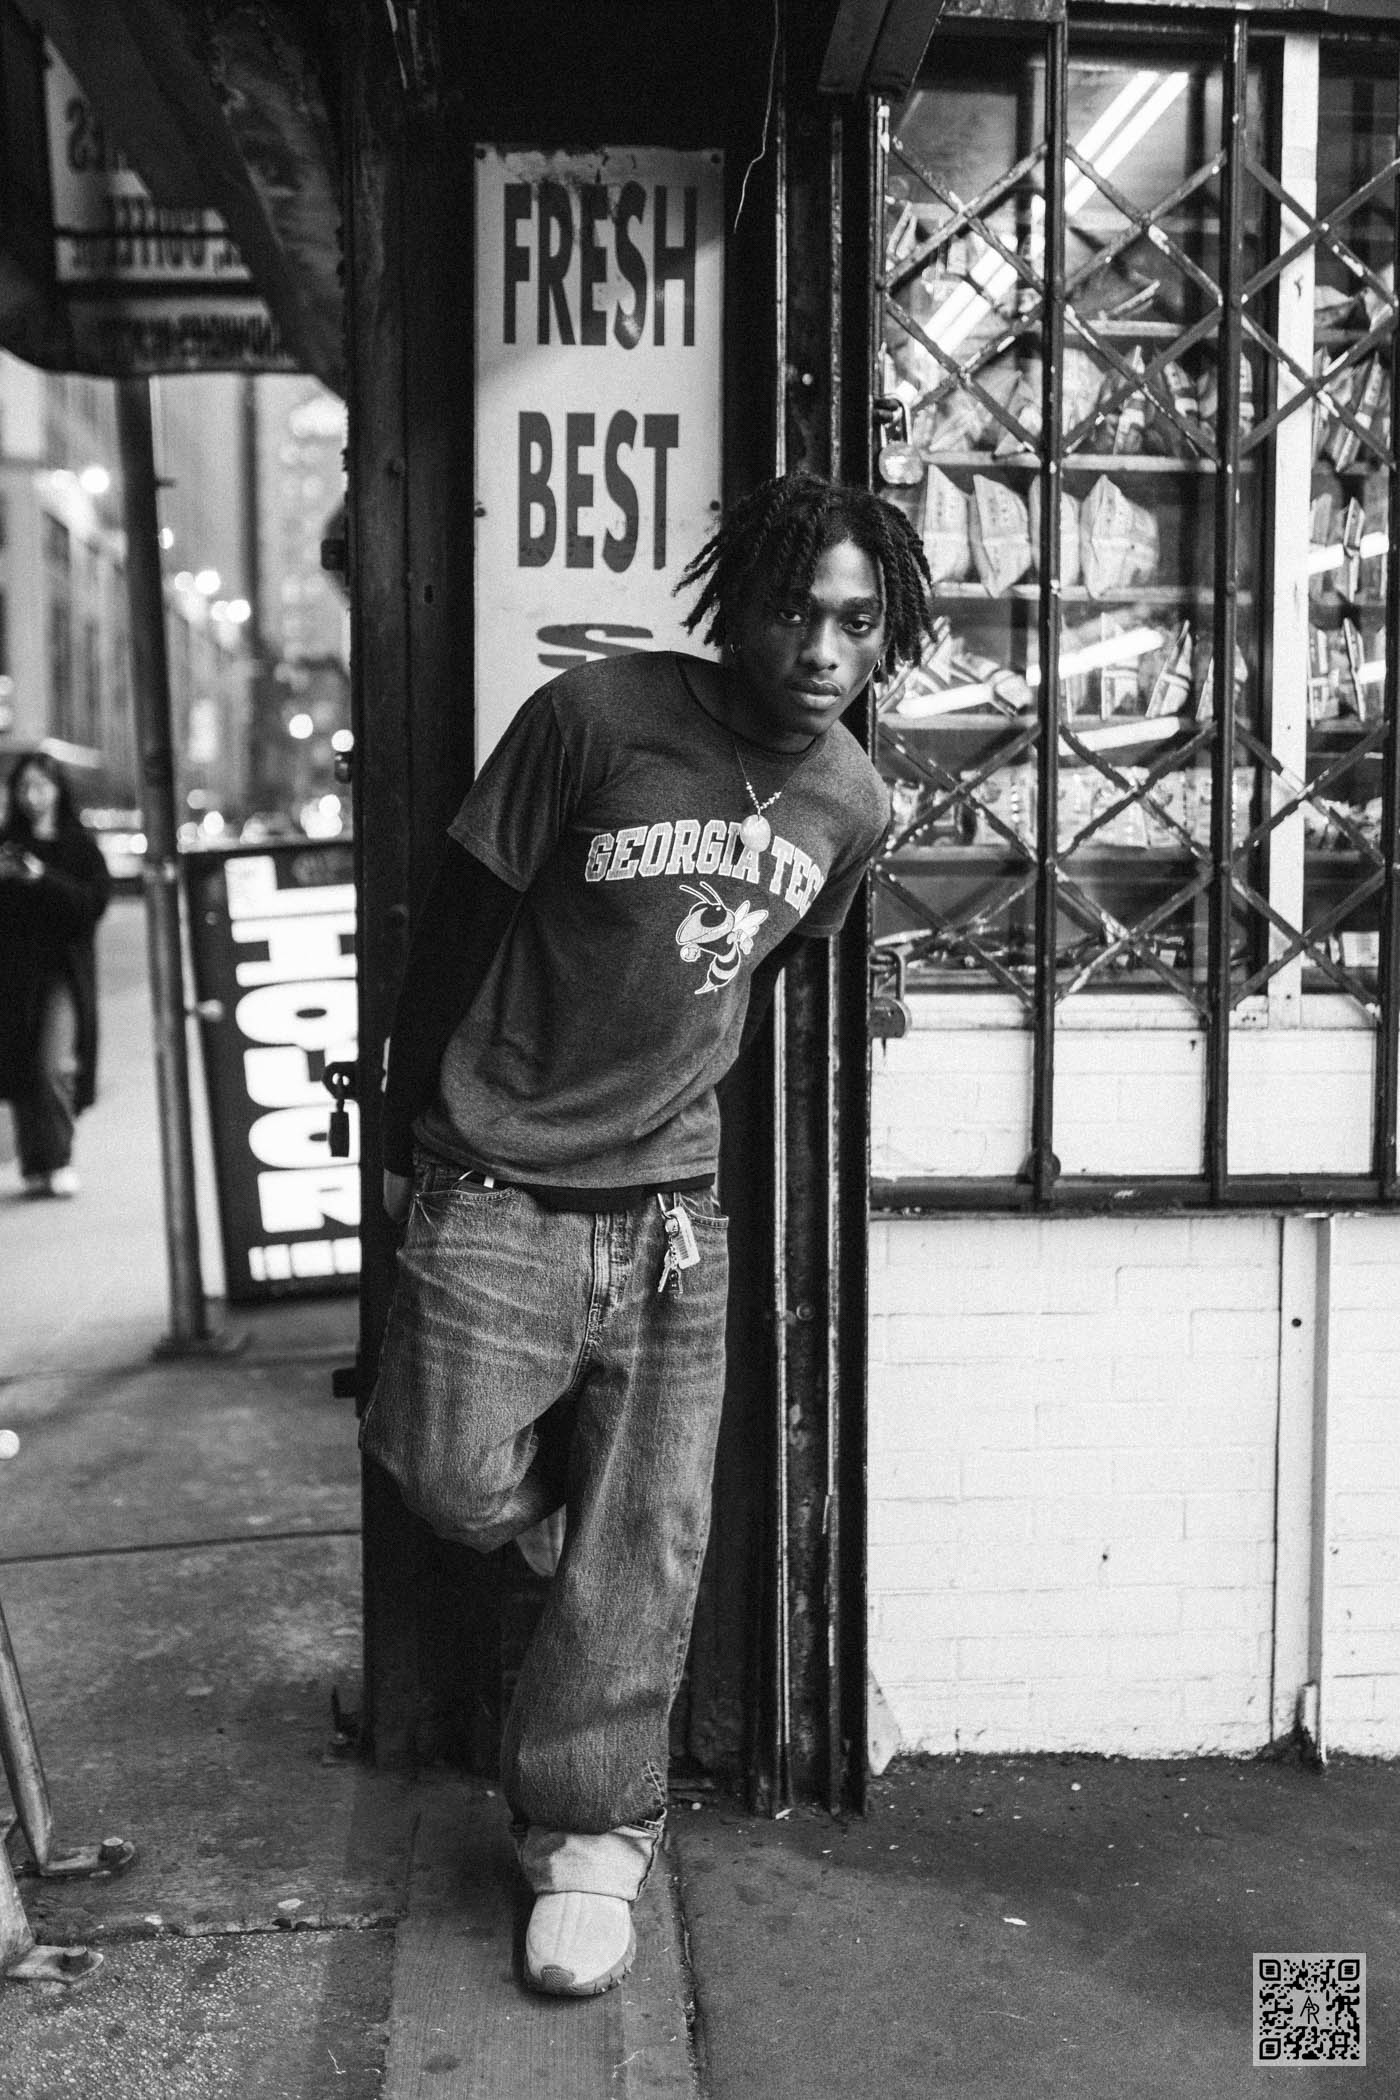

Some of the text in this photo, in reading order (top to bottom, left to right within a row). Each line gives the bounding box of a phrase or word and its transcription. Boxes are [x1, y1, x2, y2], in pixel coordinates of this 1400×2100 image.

[503, 180, 696, 350] FRESH
[518, 409, 680, 573] BEST
[585, 819, 826, 919] GEORGIA TEC
